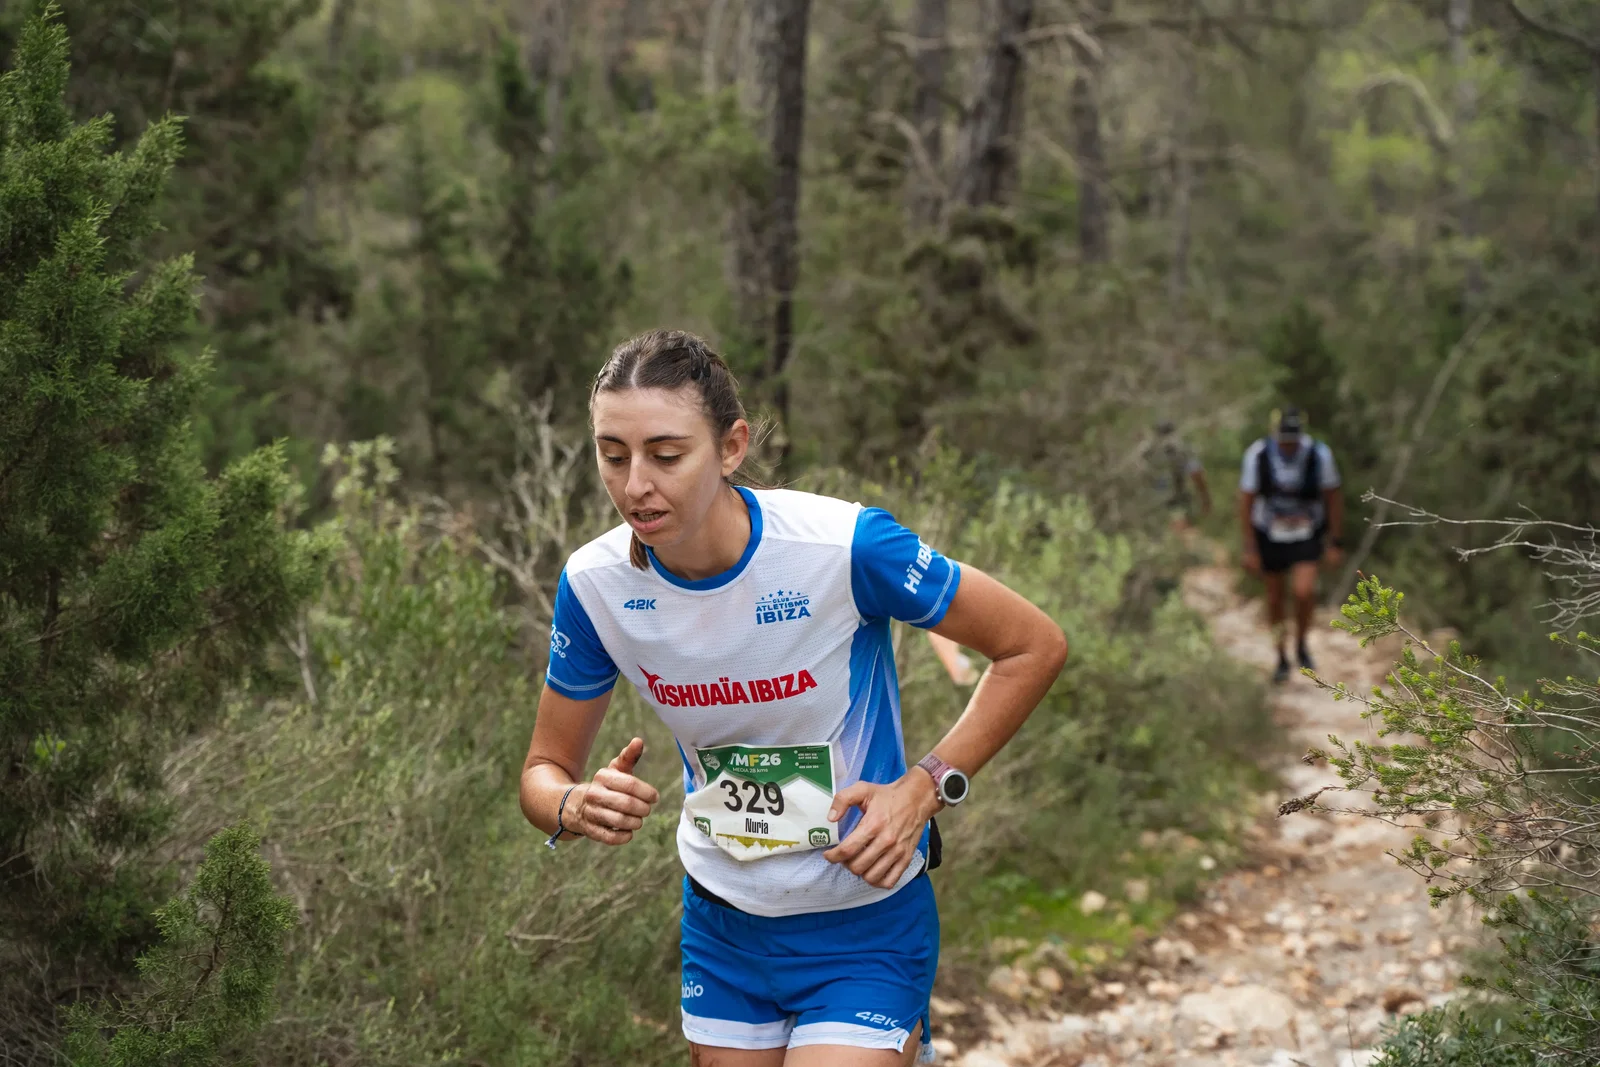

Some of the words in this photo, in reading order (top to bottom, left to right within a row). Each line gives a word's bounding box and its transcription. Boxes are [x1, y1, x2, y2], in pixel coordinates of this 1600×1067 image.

[623, 599, 656, 610] 42K
[756, 599, 810, 612] ATLETISMO
[756, 606, 811, 625] IBIZA
[650, 675, 750, 707] USHUAÏA
[748, 669, 818, 703] IBIZA
[720, 779, 785, 816] 329
[745, 818, 769, 835] Nuria
[855, 1011, 899, 1027] 42K
